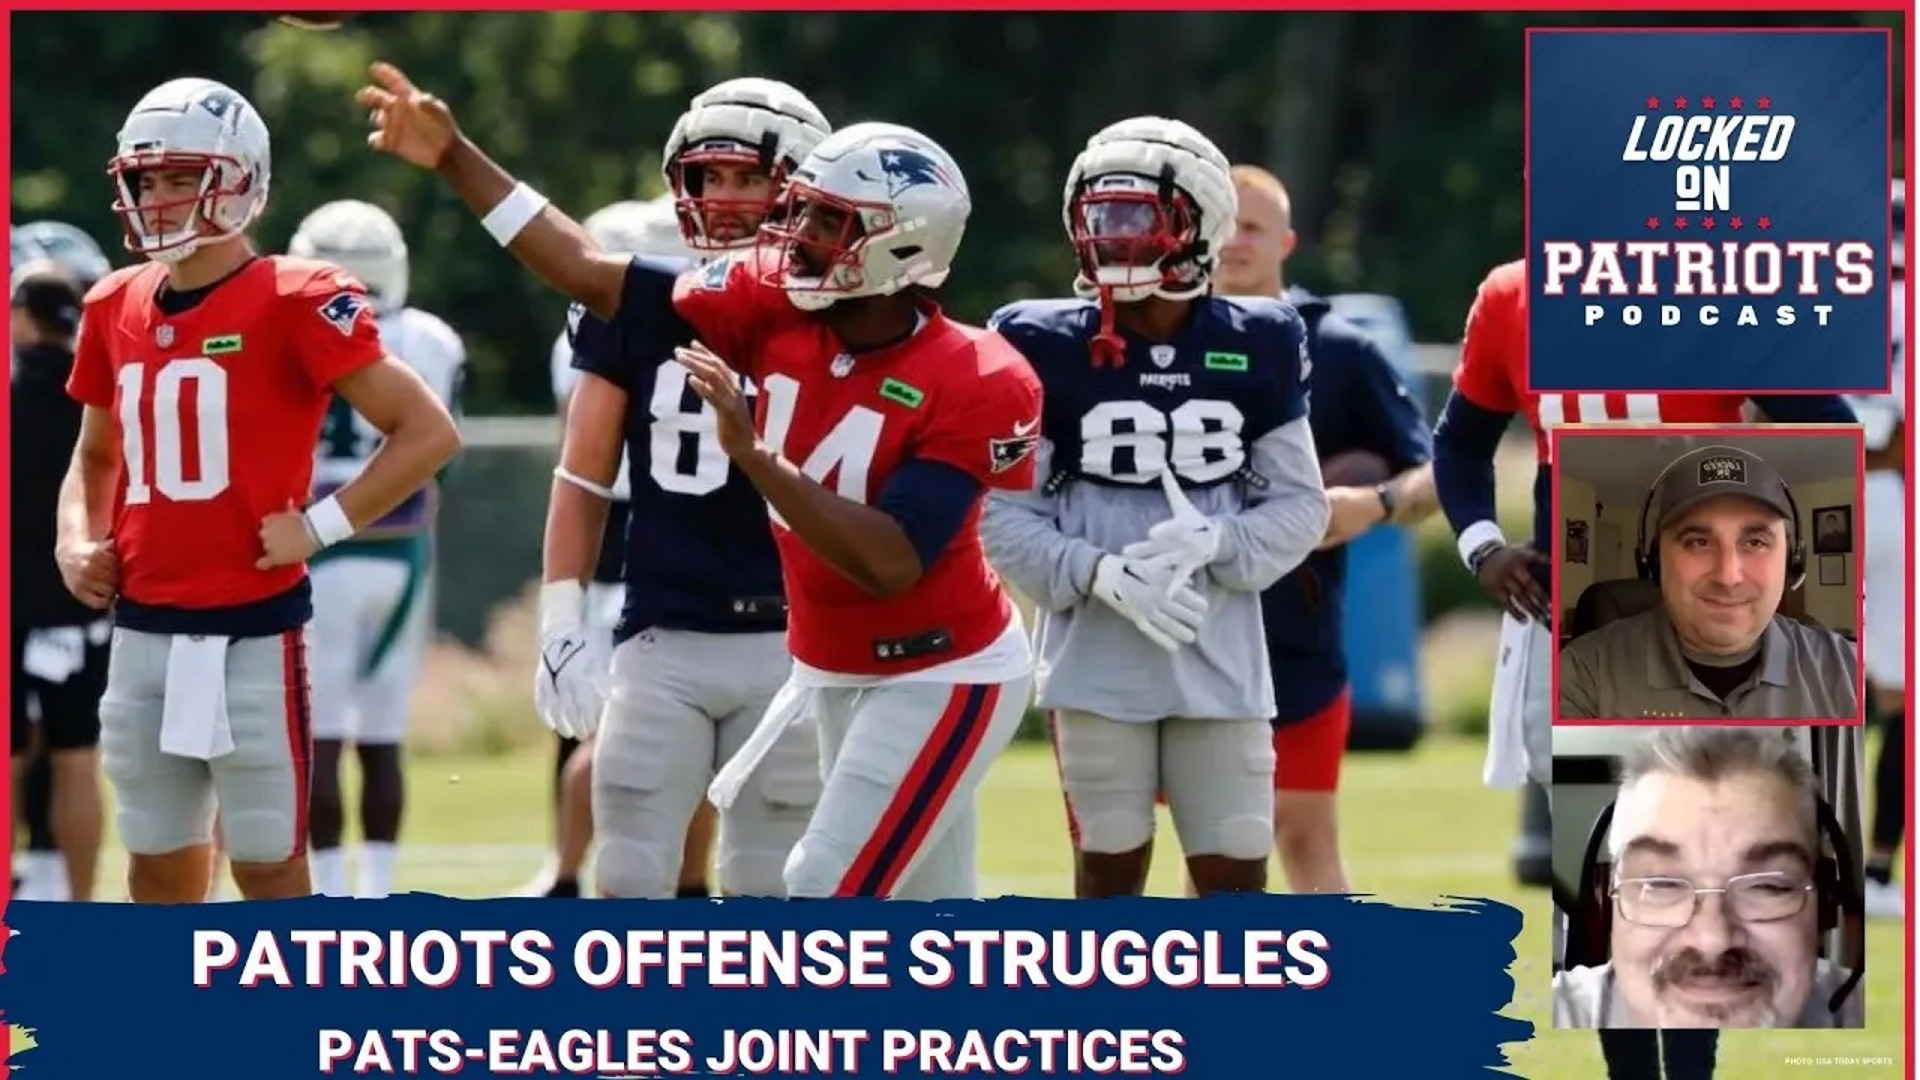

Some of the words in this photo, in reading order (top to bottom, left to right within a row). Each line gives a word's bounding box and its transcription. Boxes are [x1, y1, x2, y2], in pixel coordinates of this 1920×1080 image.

[118, 358, 230, 505] 10
[762, 373, 885, 532] 14
[1081, 399, 1245, 484] 88
